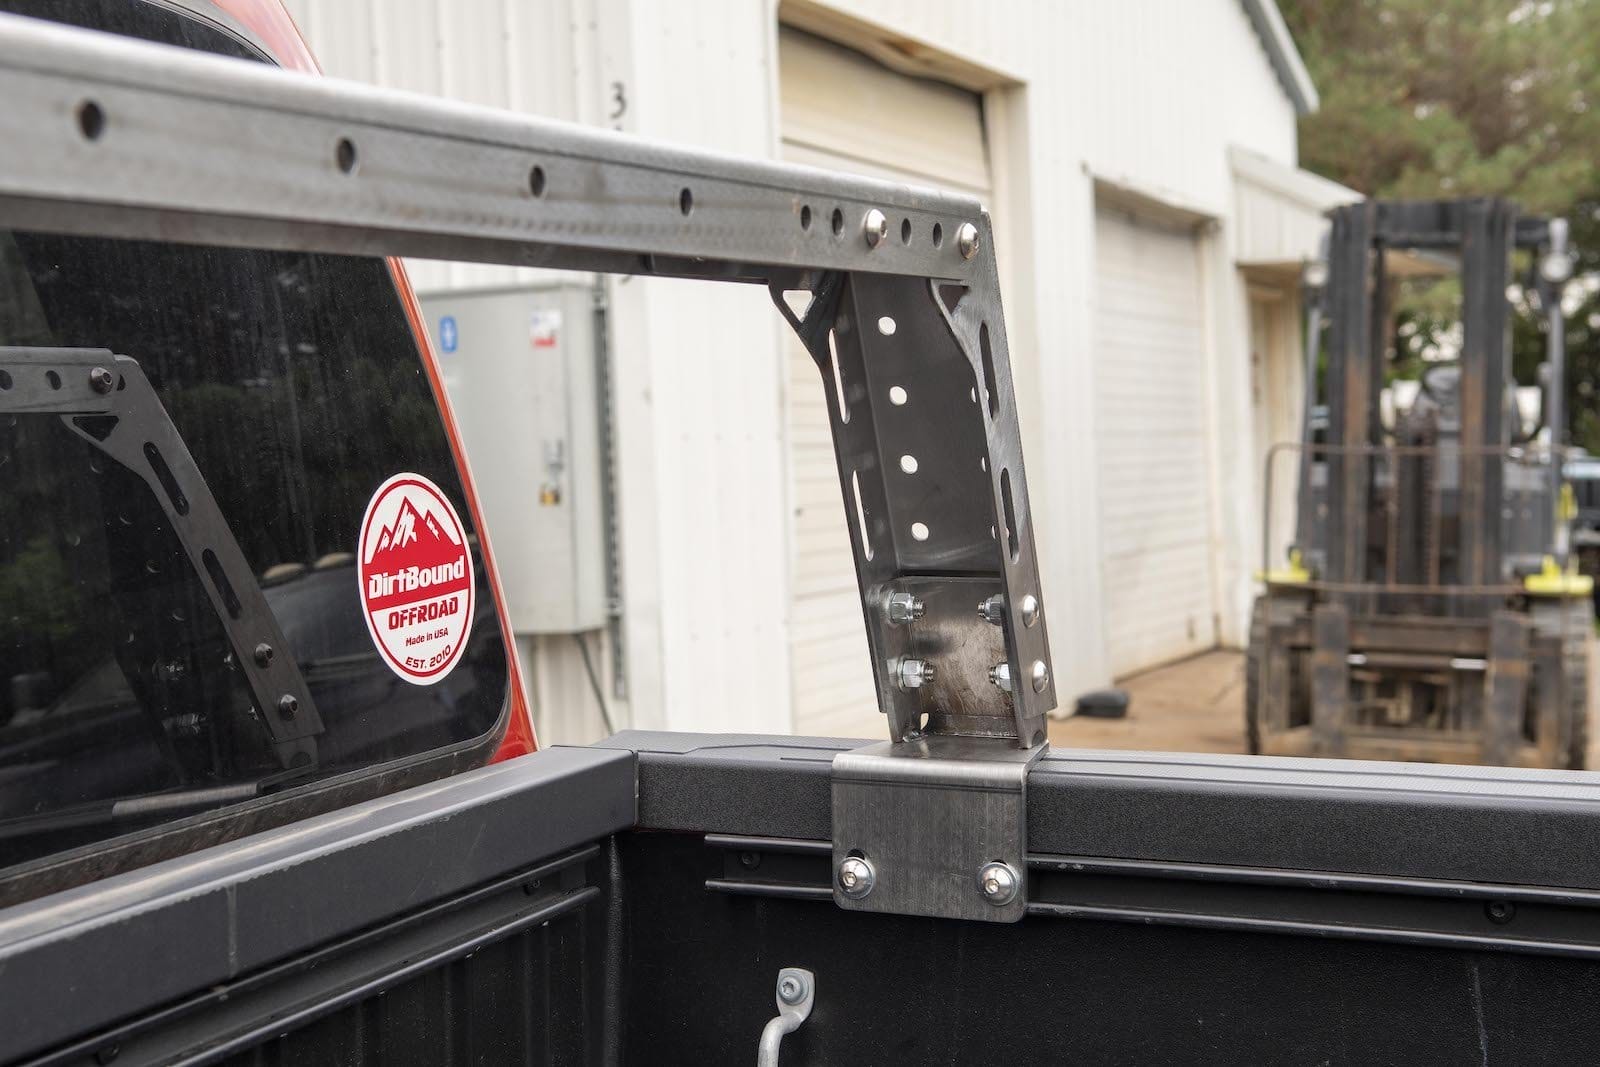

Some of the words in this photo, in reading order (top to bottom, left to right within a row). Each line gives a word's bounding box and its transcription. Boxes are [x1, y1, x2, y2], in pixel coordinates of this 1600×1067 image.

[369, 555, 464, 600] DirtBound
[388, 597, 458, 630] OFFROAD
[405, 635, 425, 647] Made
[426, 632, 433, 641] in
[434, 627, 449, 639] USA
[405, 656, 428, 669] EST.
[429, 644, 451, 668] 2010
